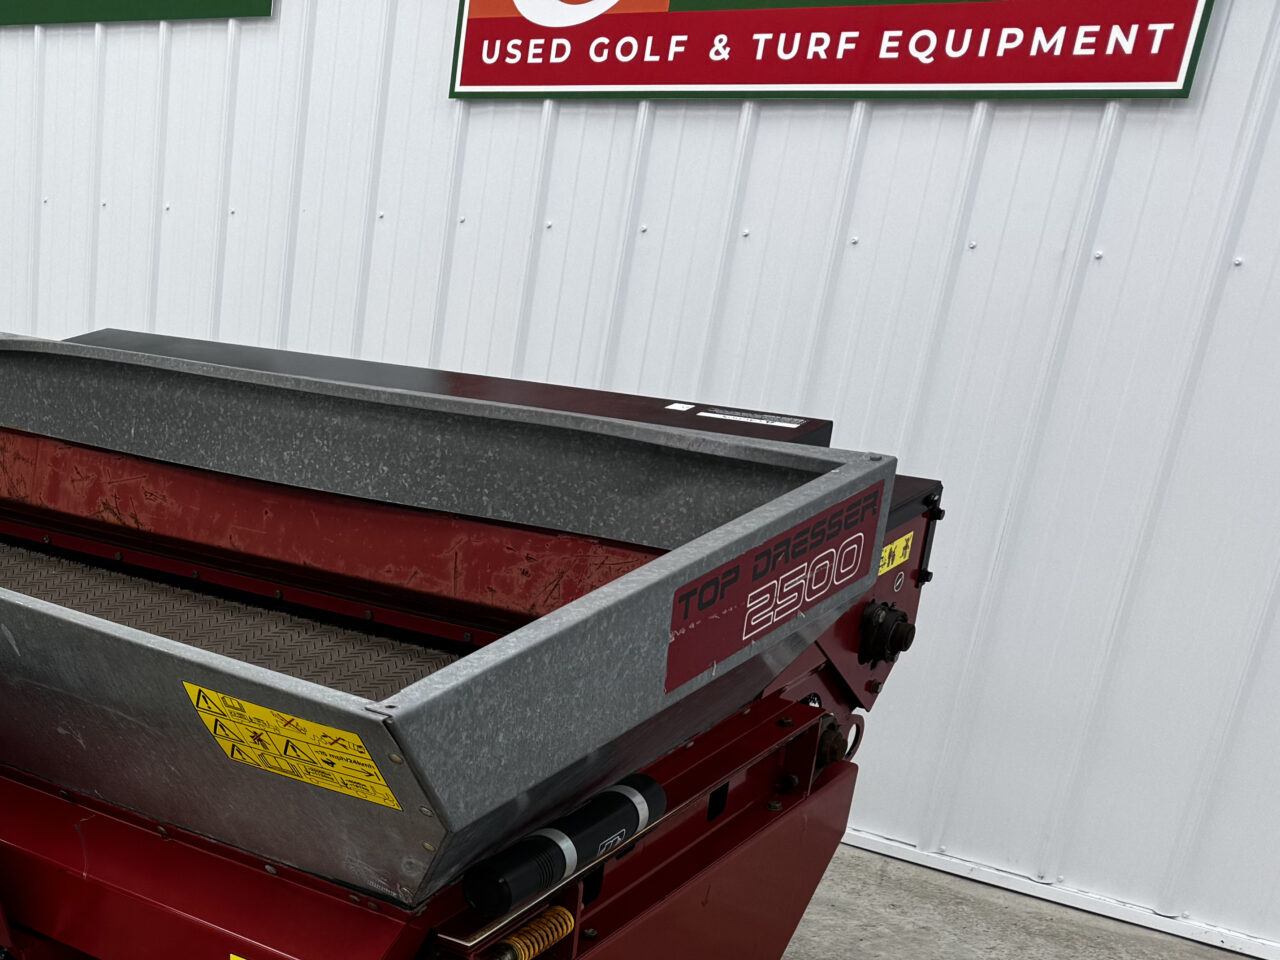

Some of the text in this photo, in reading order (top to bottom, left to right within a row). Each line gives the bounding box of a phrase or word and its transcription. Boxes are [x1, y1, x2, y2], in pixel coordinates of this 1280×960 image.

[481, 23, 1175, 64] USED GOLF & TURF EQUIPMENT
[678, 491, 879, 620] TOP DRESSER
[742, 532, 864, 641] 2500
